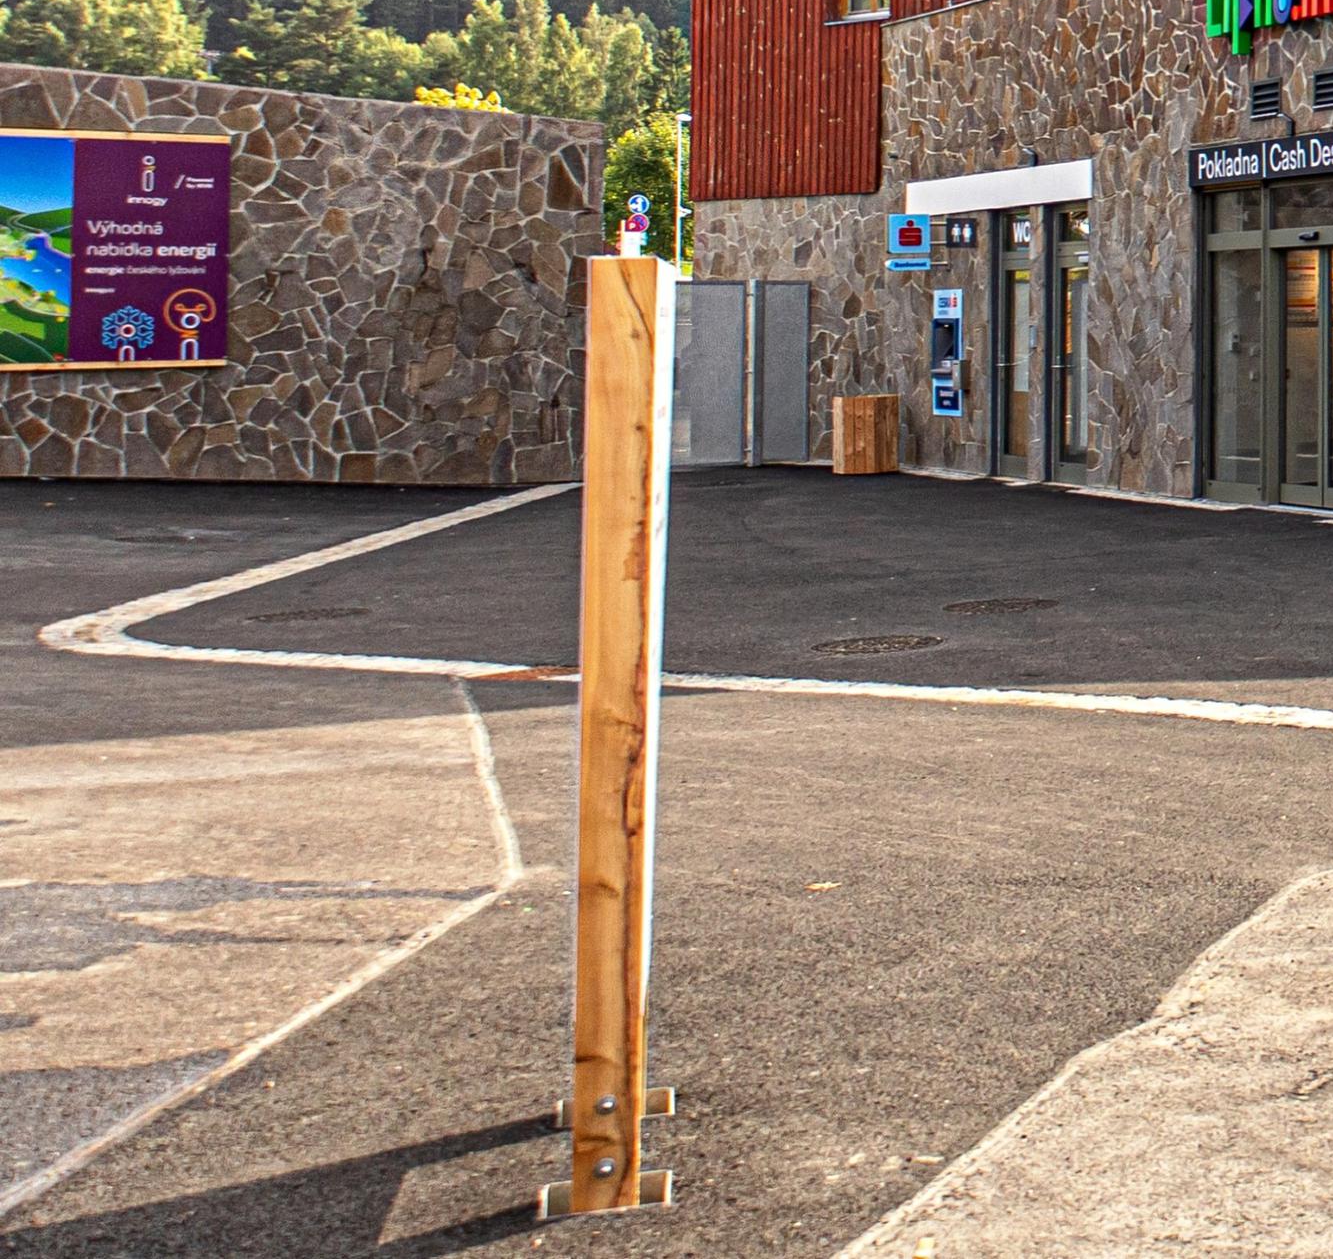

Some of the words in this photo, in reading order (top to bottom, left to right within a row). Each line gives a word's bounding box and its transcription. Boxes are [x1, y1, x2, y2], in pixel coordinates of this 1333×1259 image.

[1198, 148, 1259, 179] Pokladna
[1269, 141, 1306, 172] Cash
[87, 221, 163, 237] Výhodná
[1013, 222, 1031, 243] WC
